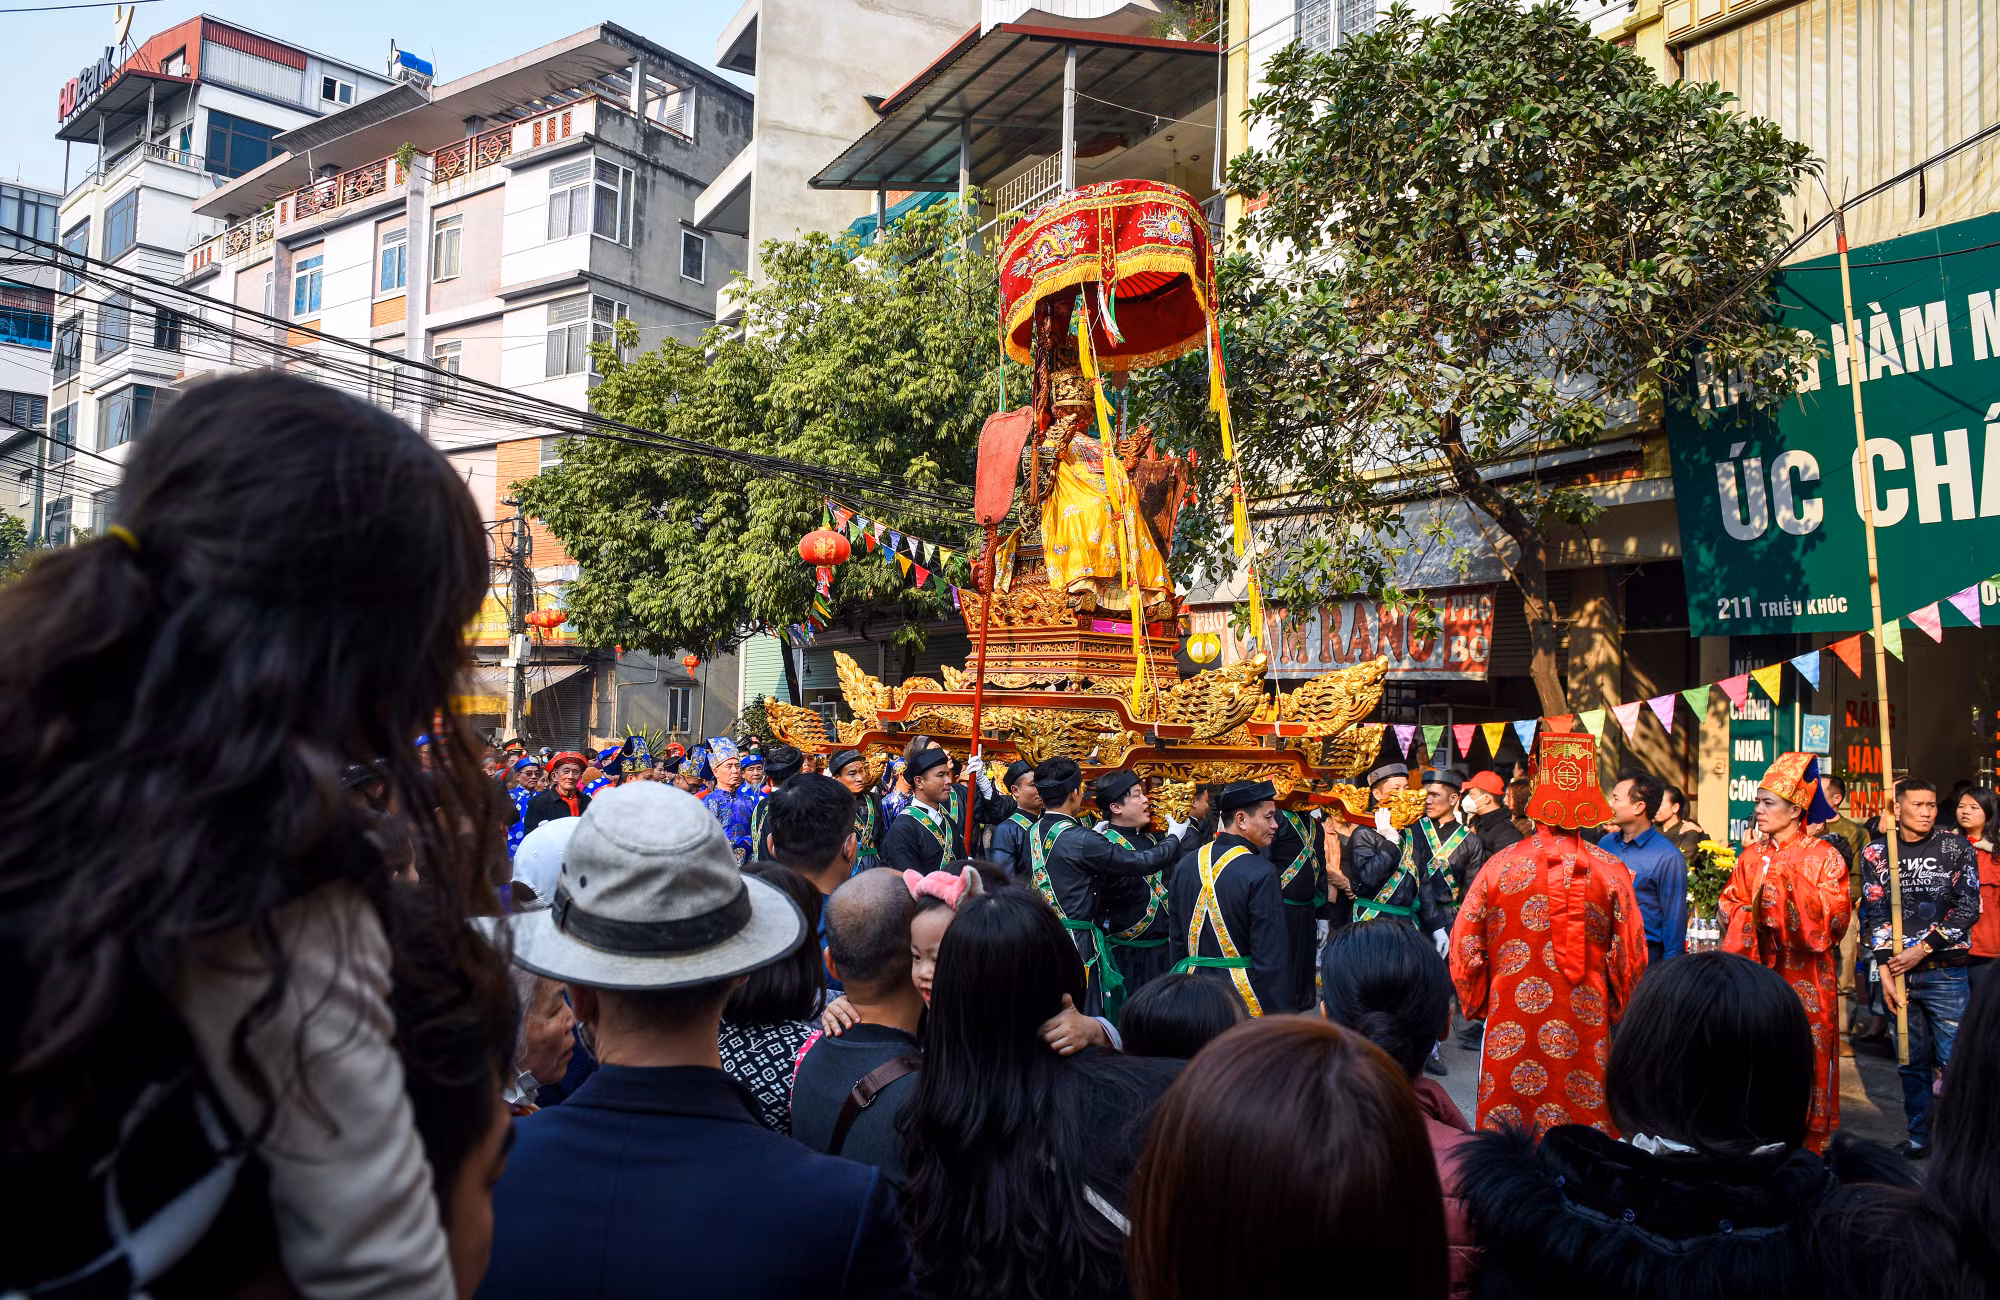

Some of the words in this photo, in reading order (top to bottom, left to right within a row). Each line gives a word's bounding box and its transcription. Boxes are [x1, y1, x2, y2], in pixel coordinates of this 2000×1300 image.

[57, 45, 115, 123] HDBank
[1830, 301, 1953, 387] HÀM
[1715, 440, 1824, 541] ÚC
[1717, 596, 1752, 620] 211
[1760, 594, 1803, 618] TRIỀU
[1807, 594, 1849, 615] KHÚC
[1448, 627, 1490, 663] BÒ
[1734, 739, 1765, 762] NHA
[1729, 775, 1763, 802] CÔN
